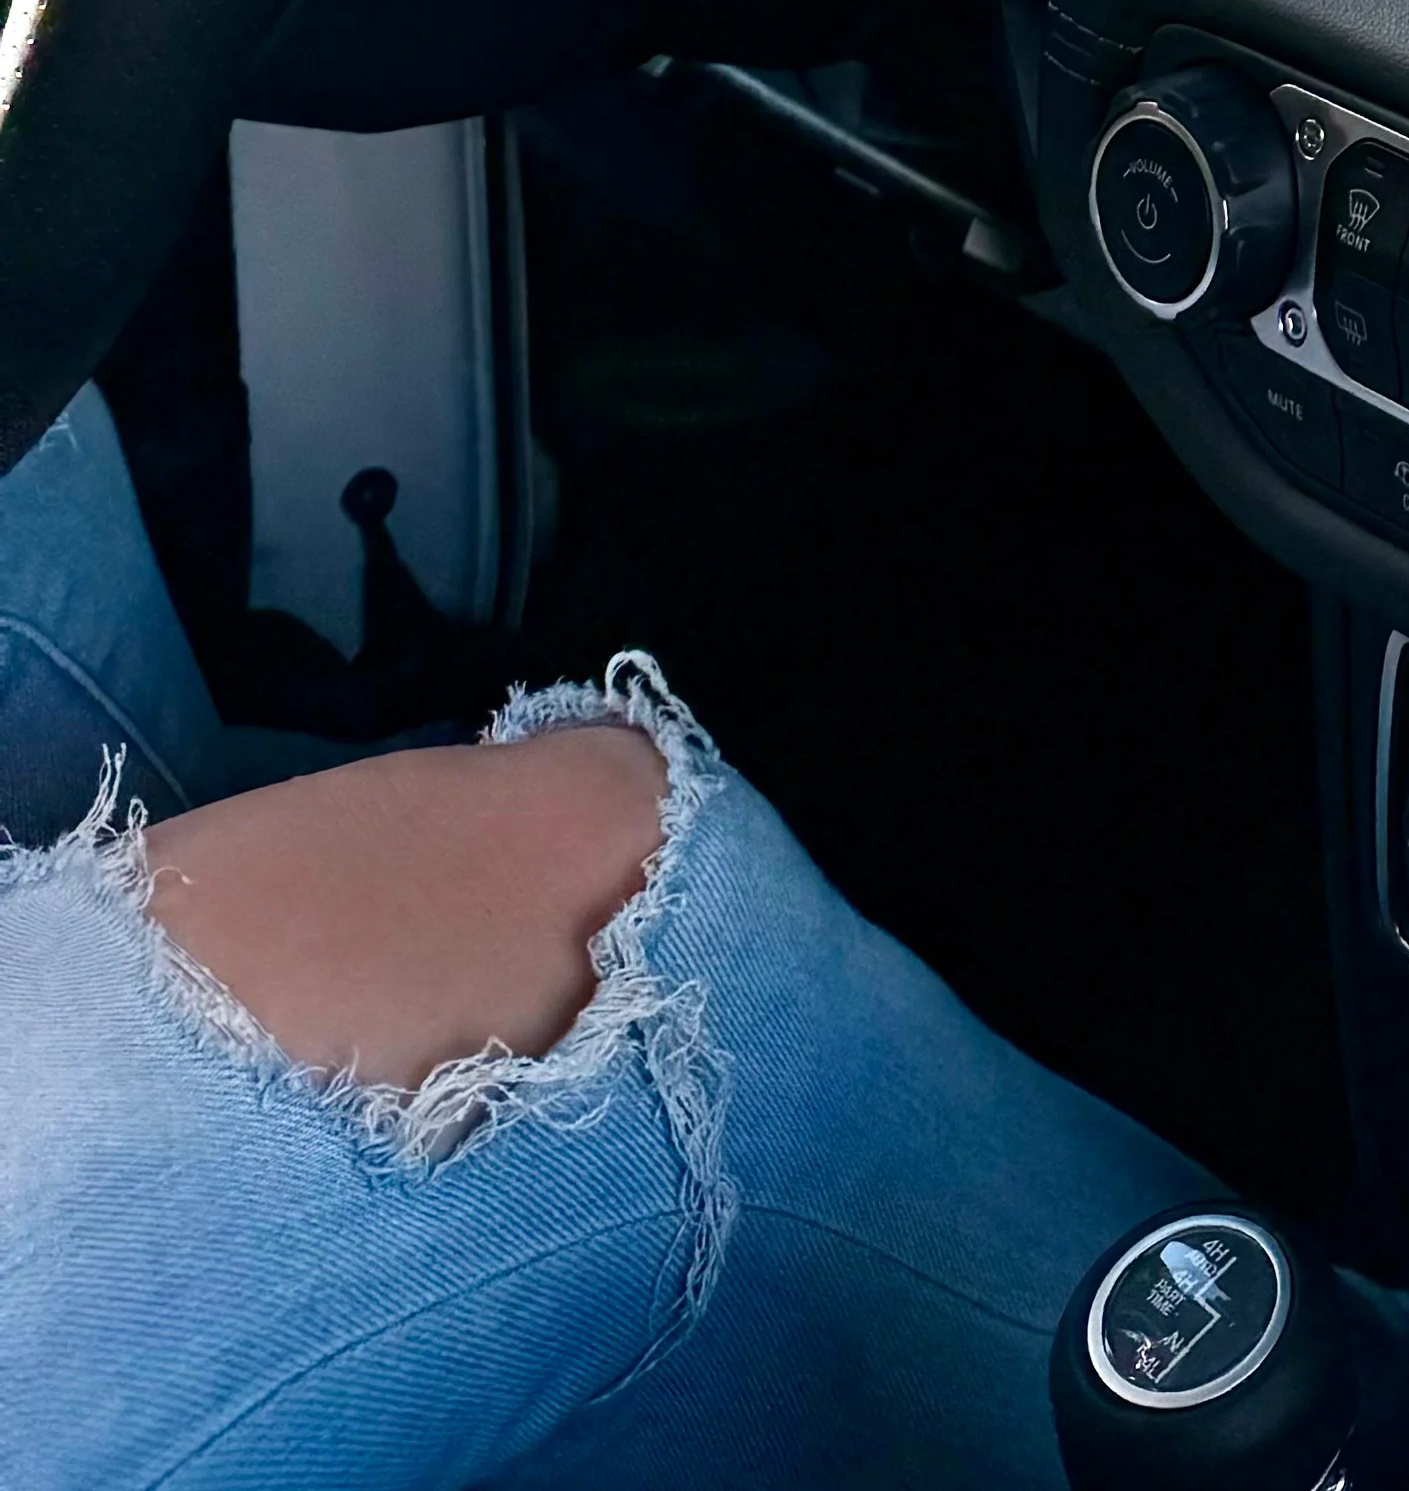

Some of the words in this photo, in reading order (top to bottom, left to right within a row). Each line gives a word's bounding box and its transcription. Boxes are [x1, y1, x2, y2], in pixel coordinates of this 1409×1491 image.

[1336, 224, 1371, 253] FRONT
[1267, 388, 1304, 421] MUTE
[1183, 1249, 1218, 1279] AUTO
[1145, 1288, 1177, 1316] TIME
[1153, 1278, 1187, 1306] PART
